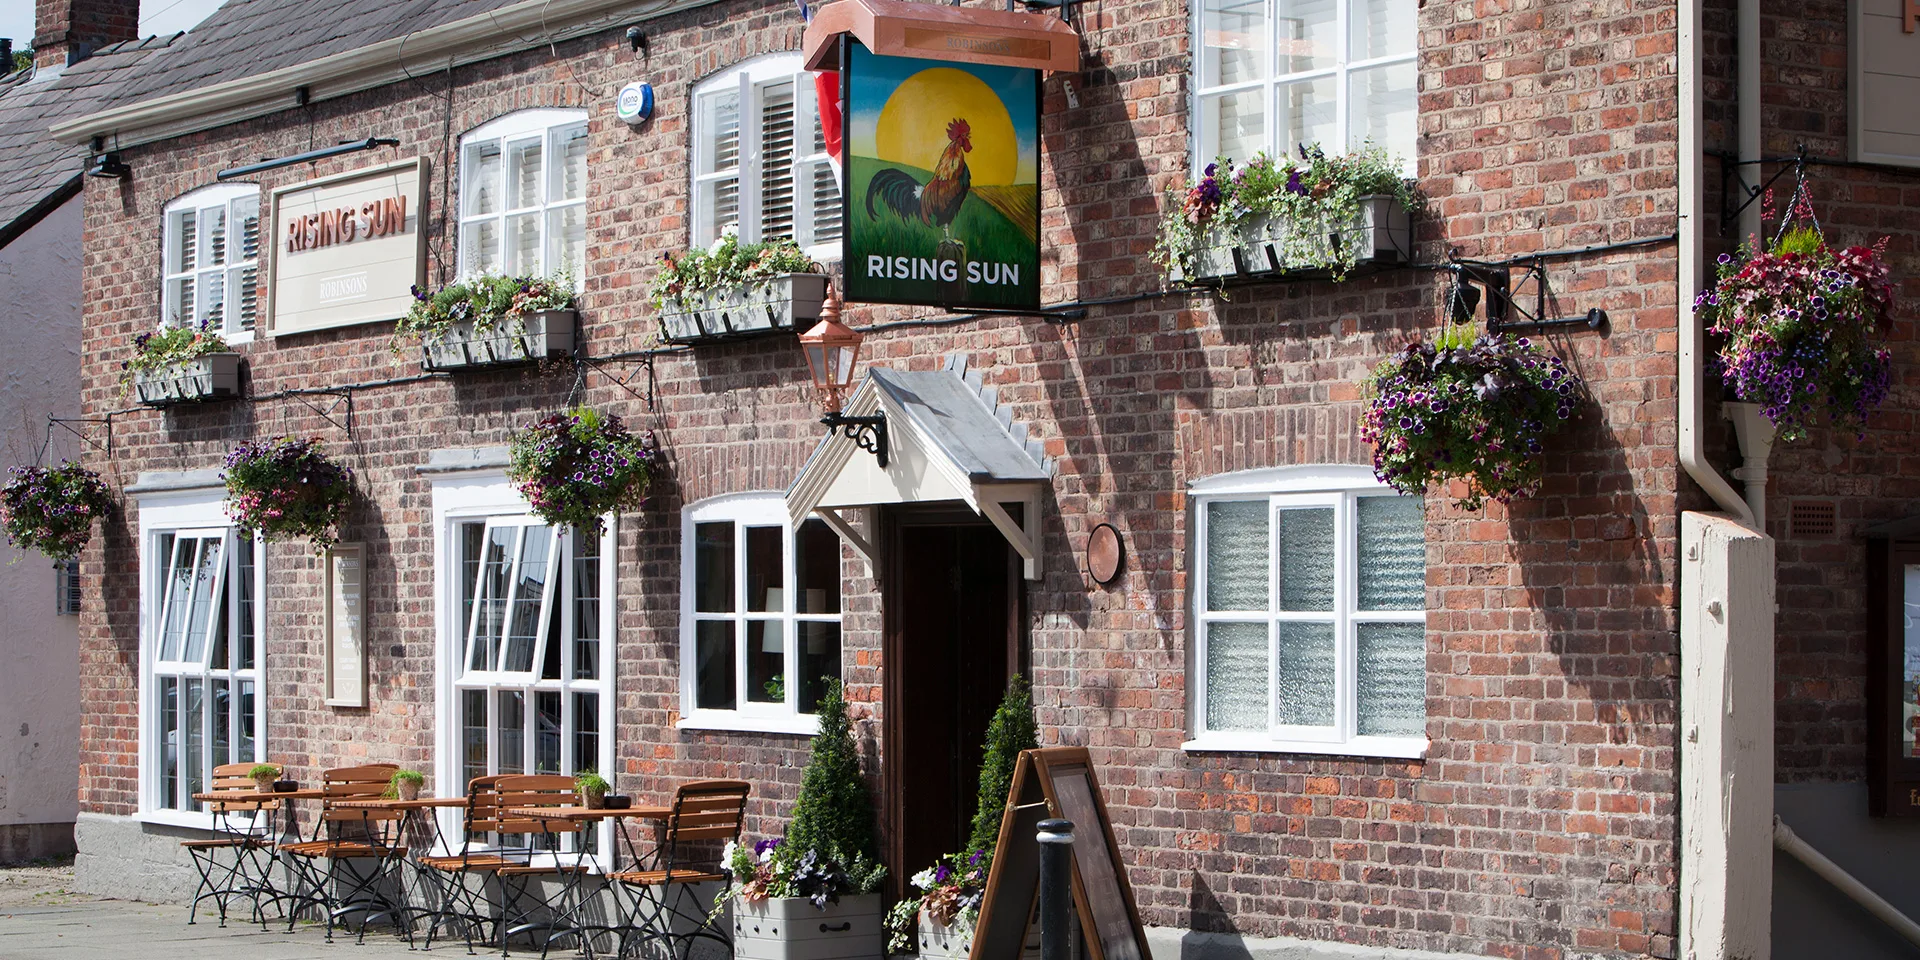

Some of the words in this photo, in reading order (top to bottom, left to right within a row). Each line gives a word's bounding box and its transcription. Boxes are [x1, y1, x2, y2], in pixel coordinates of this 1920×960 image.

[947, 37, 1010, 53] ROBINSONS
[287, 205, 355, 253] RISING
[360, 194, 407, 239] SUN
[867, 255, 958, 282] RISING
[966, 260, 1019, 286] SUN
[319, 275, 368, 299] ROBINSONS
